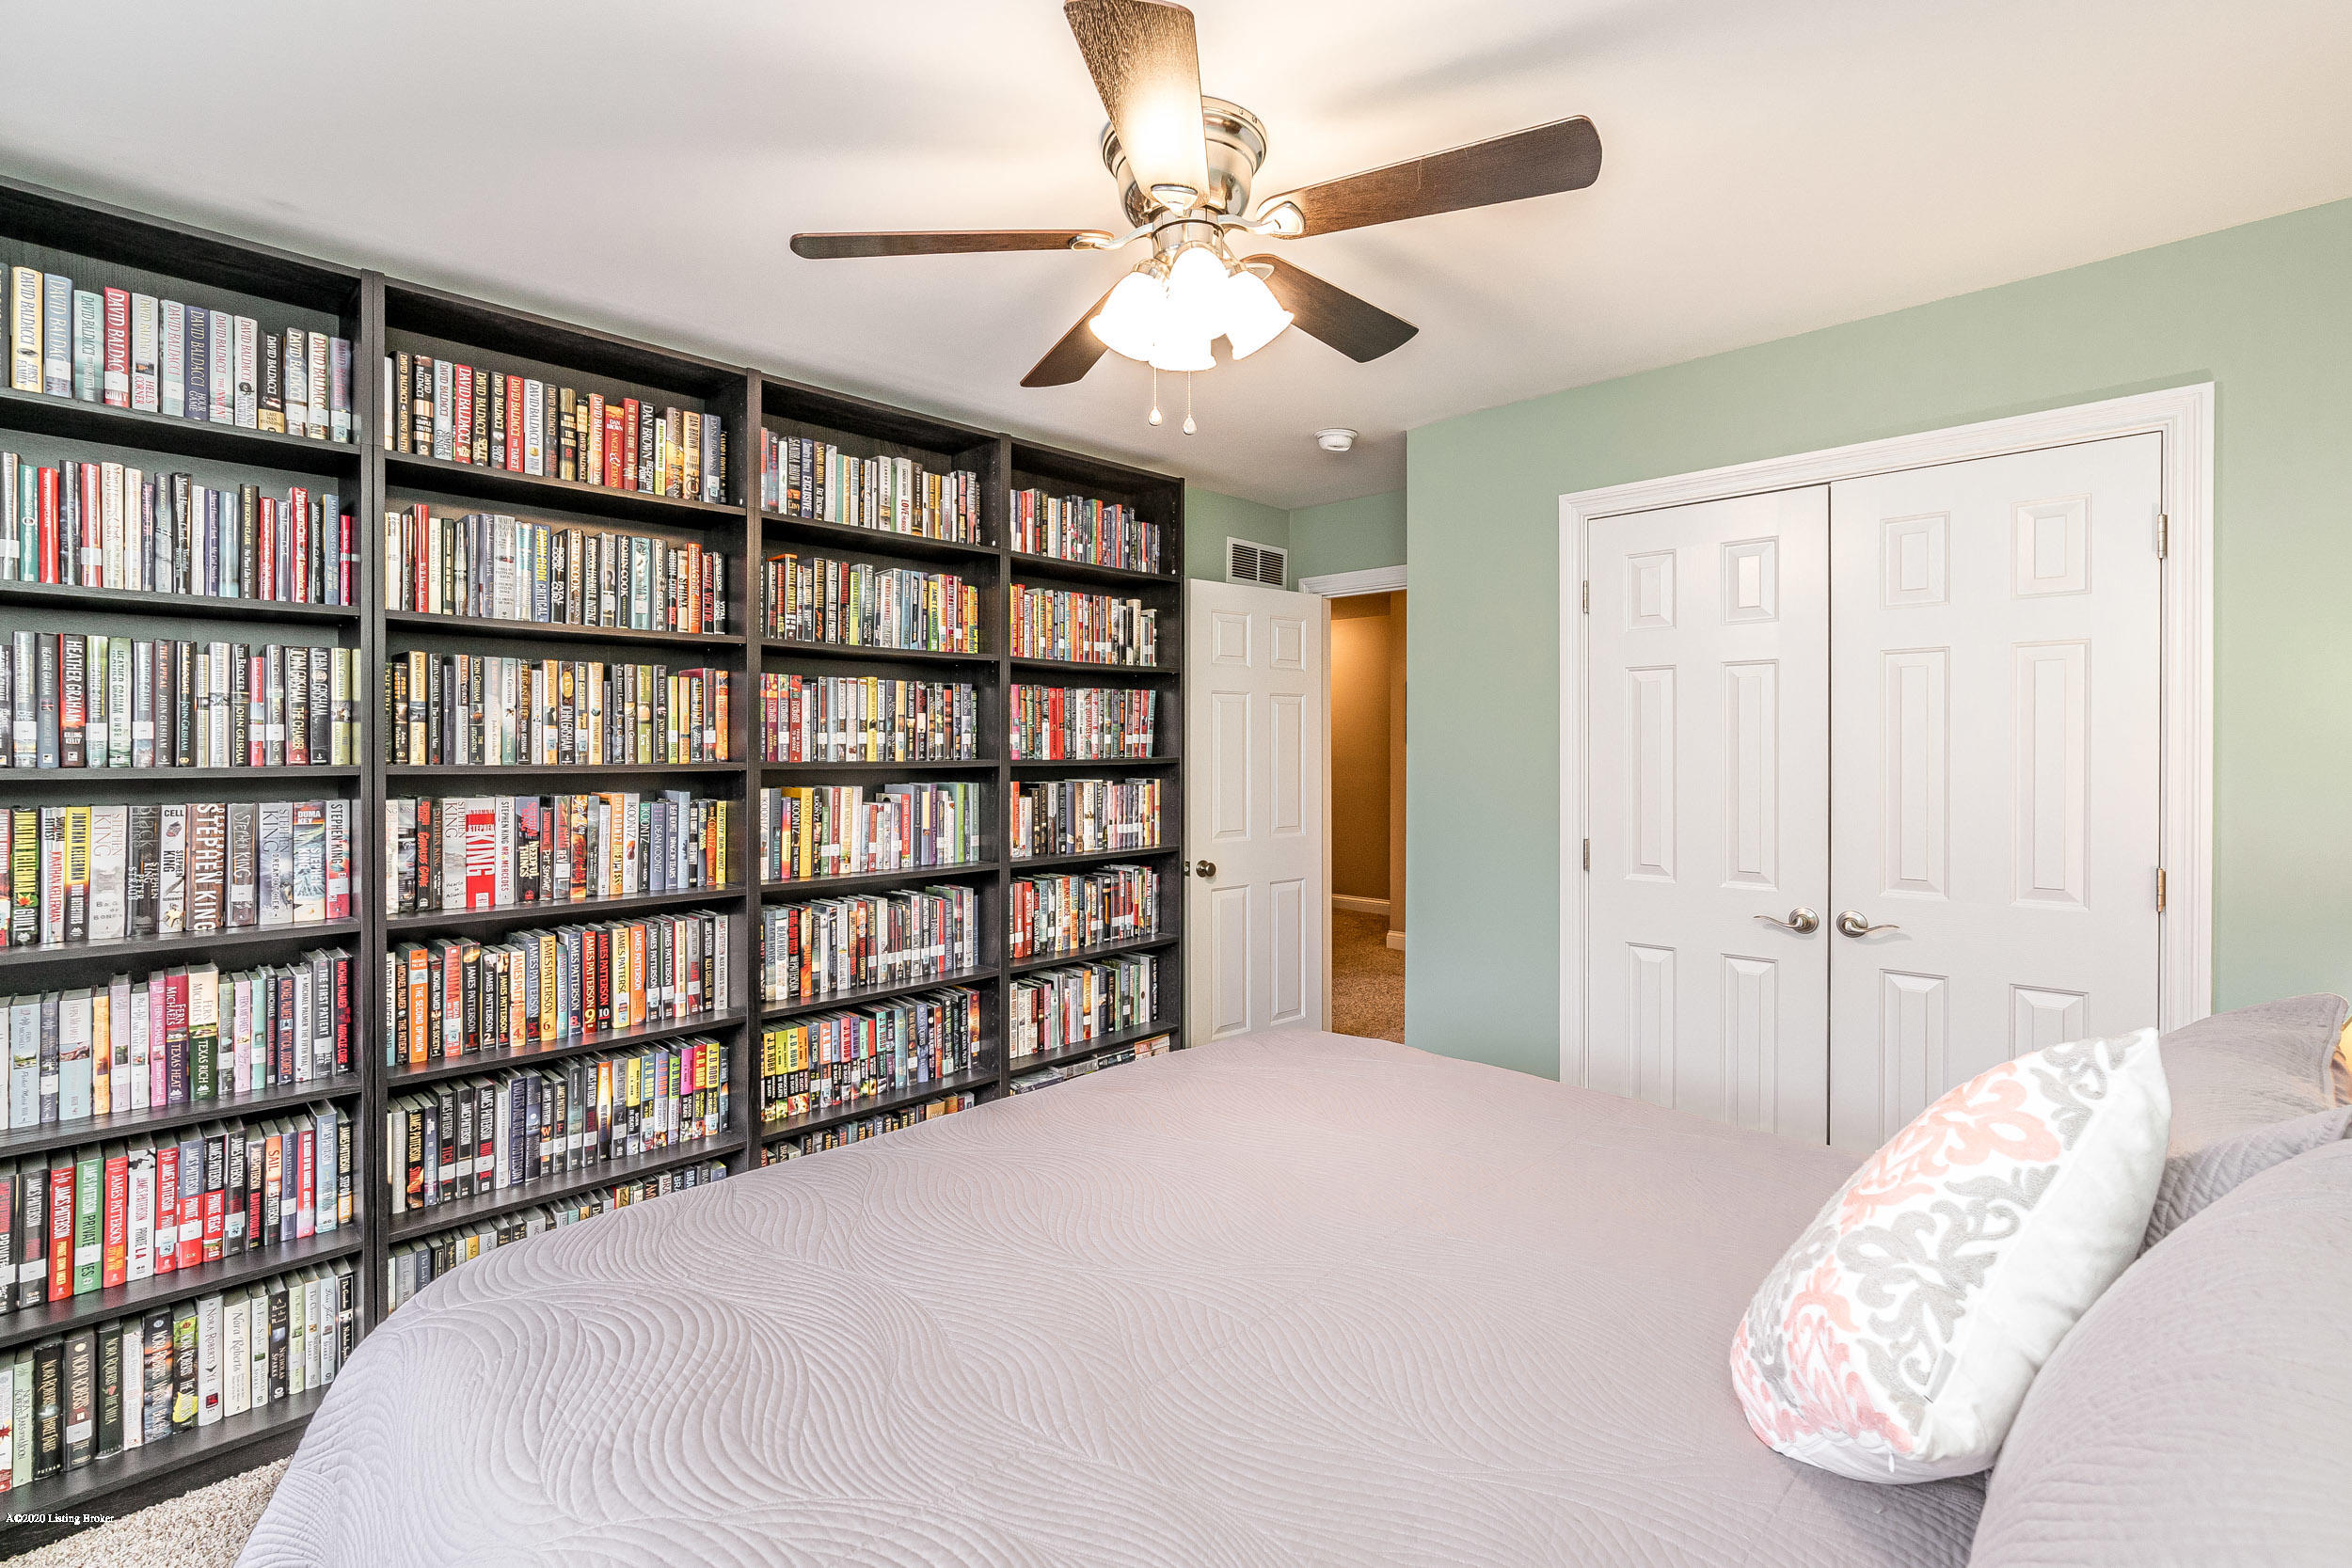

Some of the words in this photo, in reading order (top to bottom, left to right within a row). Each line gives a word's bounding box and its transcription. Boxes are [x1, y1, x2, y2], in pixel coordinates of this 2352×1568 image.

[21, 271, 35, 300] DAVID
[107, 292, 125, 326] DAVID
[20, 301, 35, 346] BALDACCI
[190, 310, 204, 340] DAVID
[215, 315, 227, 337] DAVID
[107, 328, 125, 372] BALDAC
[215, 339, 227, 374] BALDACCI
[16, 359, 27, 386] FAMILY
[28, 364, 39, 385] FIRST
[191, 341, 204, 388] BALDACCI
[135, 375, 145, 404] CORNER
[146, 380, 155, 404] HELL'S
[458, 368, 470, 397] DAVID
[188, 390, 198, 412] GAME
[198, 392, 207, 412] HOUR
[642, 404, 653, 426] DAN
[458, 398, 470, 444] BALDACCI
[642, 427, 654, 460] BROWN
[789, 436, 801, 463] SANDRA
[511, 448, 519, 468] TARGET
[789, 463, 801, 485] BROWN
[803, 475, 812, 511] EXCLUSIVE
[536, 583, 548, 616] CRITICAL
[679, 578, 688, 609] SPHINX
[704, 592, 713, 622] VECTOR
[65, 641, 82, 681] HEATHER
[159, 661, 167, 689] APPEAL
[236, 658, 246, 690] BROKER
[473, 658, 482, 673] JOHN
[473, 674, 482, 701] GRISHAM
[65, 683, 82, 722] GRAHAM
[159, 694, 167, 713] JOHN
[235, 705, 245, 727] JOHN
[561, 705, 573, 721] JOHN
[159, 715, 167, 748] GRISHAM
[235, 728, 245, 763] GRISHAM
[561, 722, 573, 751] GRISHAM
[140, 806, 160, 847] Black
[164, 809, 184, 817] CELL
[330, 804, 343, 841] STEPHEN
[640, 806, 650, 844] KOONTZ
[791, 803, 800, 834] KOONTZ
[14, 812, 36, 849] JONATHAN
[94, 813, 111, 857] KING
[112, 813, 123, 856] STEPHEN
[195, 804, 217, 883] STEPHEN
[215, 807, 226, 885] DESPERATION
[331, 843, 343, 864] KING
[466, 833, 495, 877] KING
[529, 840, 539, 879] NEEDFUL
[14, 850, 36, 893] KELLERMAN
[163, 850, 175, 872] KING
[519, 845, 529, 878] THINGS
[612, 844, 622, 885] BREATHLESS
[128, 866, 136, 900] STRAUB
[151, 862, 159, 899] STEPHEN
[271, 854, 279, 910] DREAMCATCHER
[542, 864, 551, 892] SEMATARY
[14, 909, 36, 931] GUILT
[194, 891, 217, 930] KING
[585, 936, 595, 959] JAMES
[777, 926, 787, 943] BEACH
[529, 942, 539, 969] JAMES
[777, 944, 787, 960] ROAD
[319, 969, 328, 983] THE
[447, 954, 459, 1000] TRAUMA
[466, 966, 476, 989] JAMES
[585, 958, 595, 1008] PATTERSON
[166, 987, 177, 1026] MICHAELS
[301, 983, 310, 1006] MICHAEL
[319, 984, 328, 1005] FIRST
[415, 986, 425, 1003] THE
[529, 969, 538, 1018] PATTERSON
[175, 1004, 186, 1024] FERN
[301, 1006, 310, 1027] PALMER
[319, 1006, 328, 1036] PATIENT
[415, 1004, 425, 1024] SECOND
[466, 990, 476, 1033] PATTERSON
[301, 1029, 310, 1038] THE
[301, 1039, 310, 1053] FIFTH
[415, 1025, 425, 1053] OPINION
[170, 1043, 182, 1069] TEXAS
[198, 1039, 209, 1064] TEXAS
[170, 1070, 181, 1088] HEAT
[198, 1066, 209, 1084] RICH
[696, 1067, 705, 1087] ROBB
[480, 1089, 493, 1109] JAMES
[480, 1109, 493, 1141] PATTERSON
[268, 1149, 279, 1171] SAIL
[442, 1145, 453, 1164] TICK
[110, 1175, 123, 1199] JAMES
[208, 1193, 221, 1214] PRIVATE
[110, 1199, 123, 1245] PATTERSON
[208, 1215, 221, 1233] VEGAS
[231, 1308, 245, 1335] Nora
[41, 1359, 57, 1378] NORA
[229, 1337, 245, 1372] Roberts
[39, 1377, 57, 1402] ROBERTS
[104, 1393, 119, 1408] THE
[104, 1407, 119, 1425] VILLA
